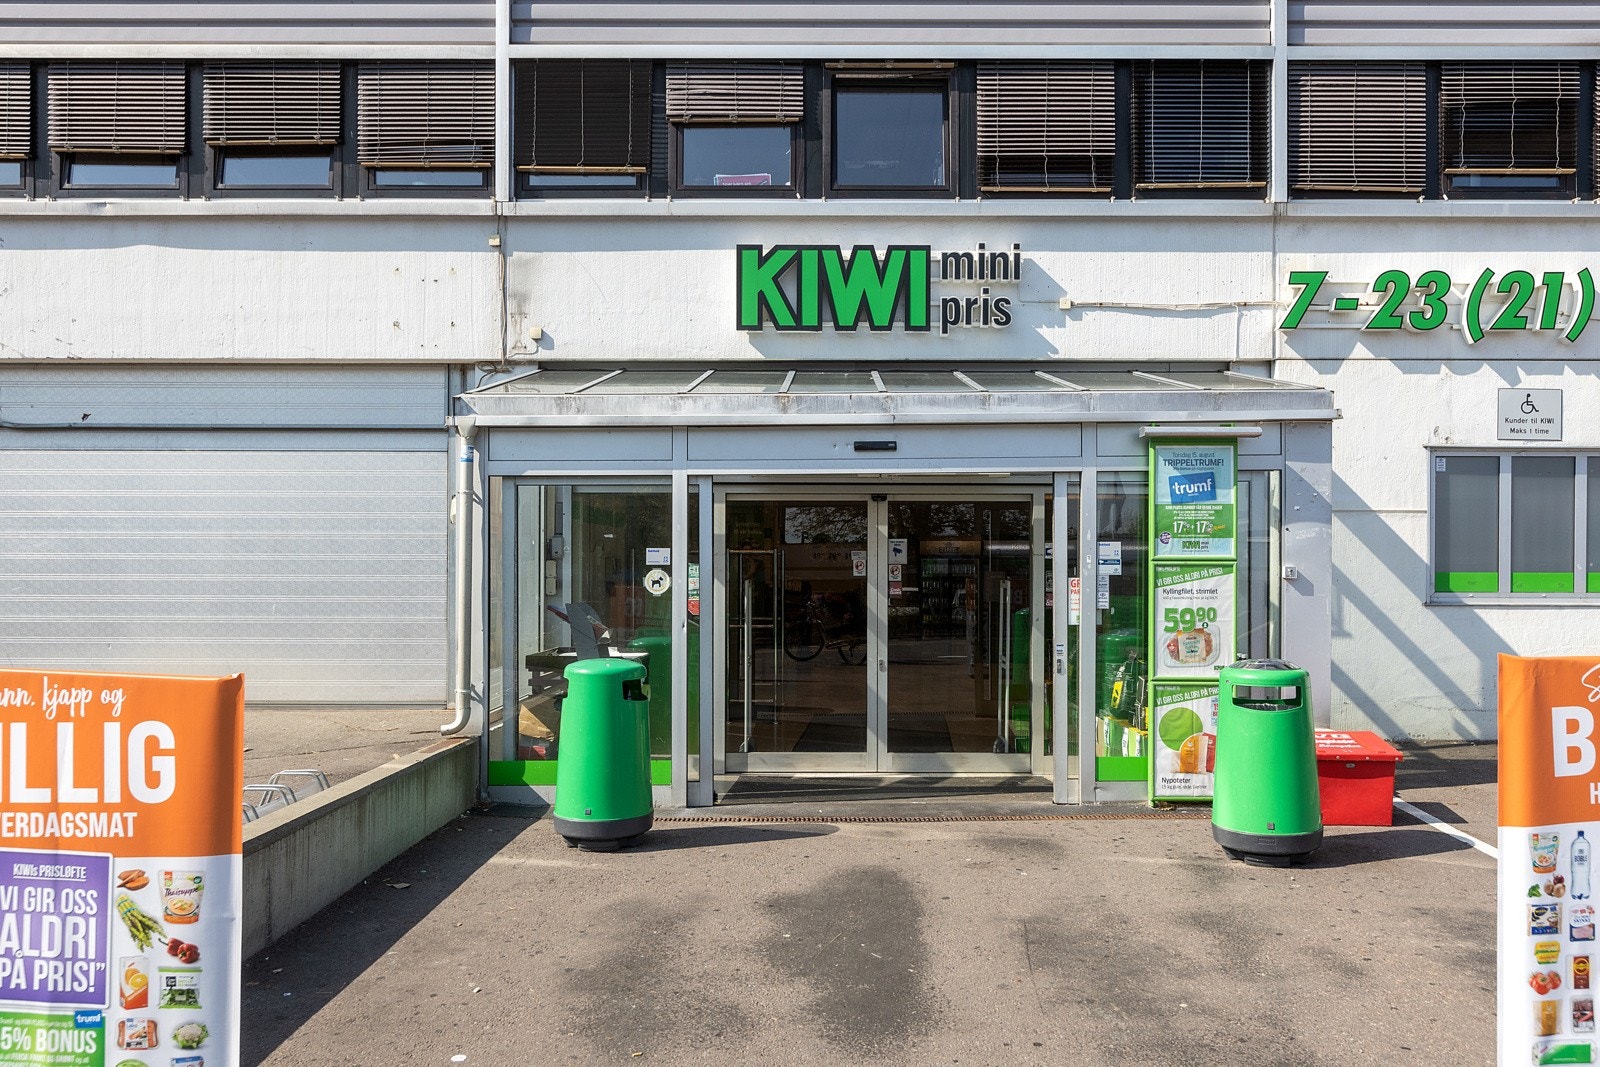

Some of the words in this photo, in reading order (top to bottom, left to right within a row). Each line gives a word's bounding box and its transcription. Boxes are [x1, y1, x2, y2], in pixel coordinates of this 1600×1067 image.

[736, 244, 931, 331] KIWI
[941, 243, 1020, 280] mini
[1279, 271, 1329, 329] 7
[1365, 270, 1451, 330] 23
[1466, 267, 1595, 343] (21)
[941, 287, 1012, 334] pris
[1174, 479, 1212, 494] trumf
[1173, 574, 1184, 584] OSS
[1184, 570, 1201, 582] ALDRI
[42, 676, 93, 720] kjapp
[101, 688, 127, 717] og
[1551, 706, 1596, 777] B
[0, 720, 176, 804] LLIG
[0, 812, 138, 838] ERDAGSMAT
[39, 865, 87, 879] PRISLØFTE
[0, 885, 19, 911] VI
[23, 886, 55, 913] GIR
[61, 888, 98, 915] OSS
[0, 913, 97, 960] ALDRI
[76, 1014, 101, 1023] trumf
[35, 1028, 97, 1054] BONUS
